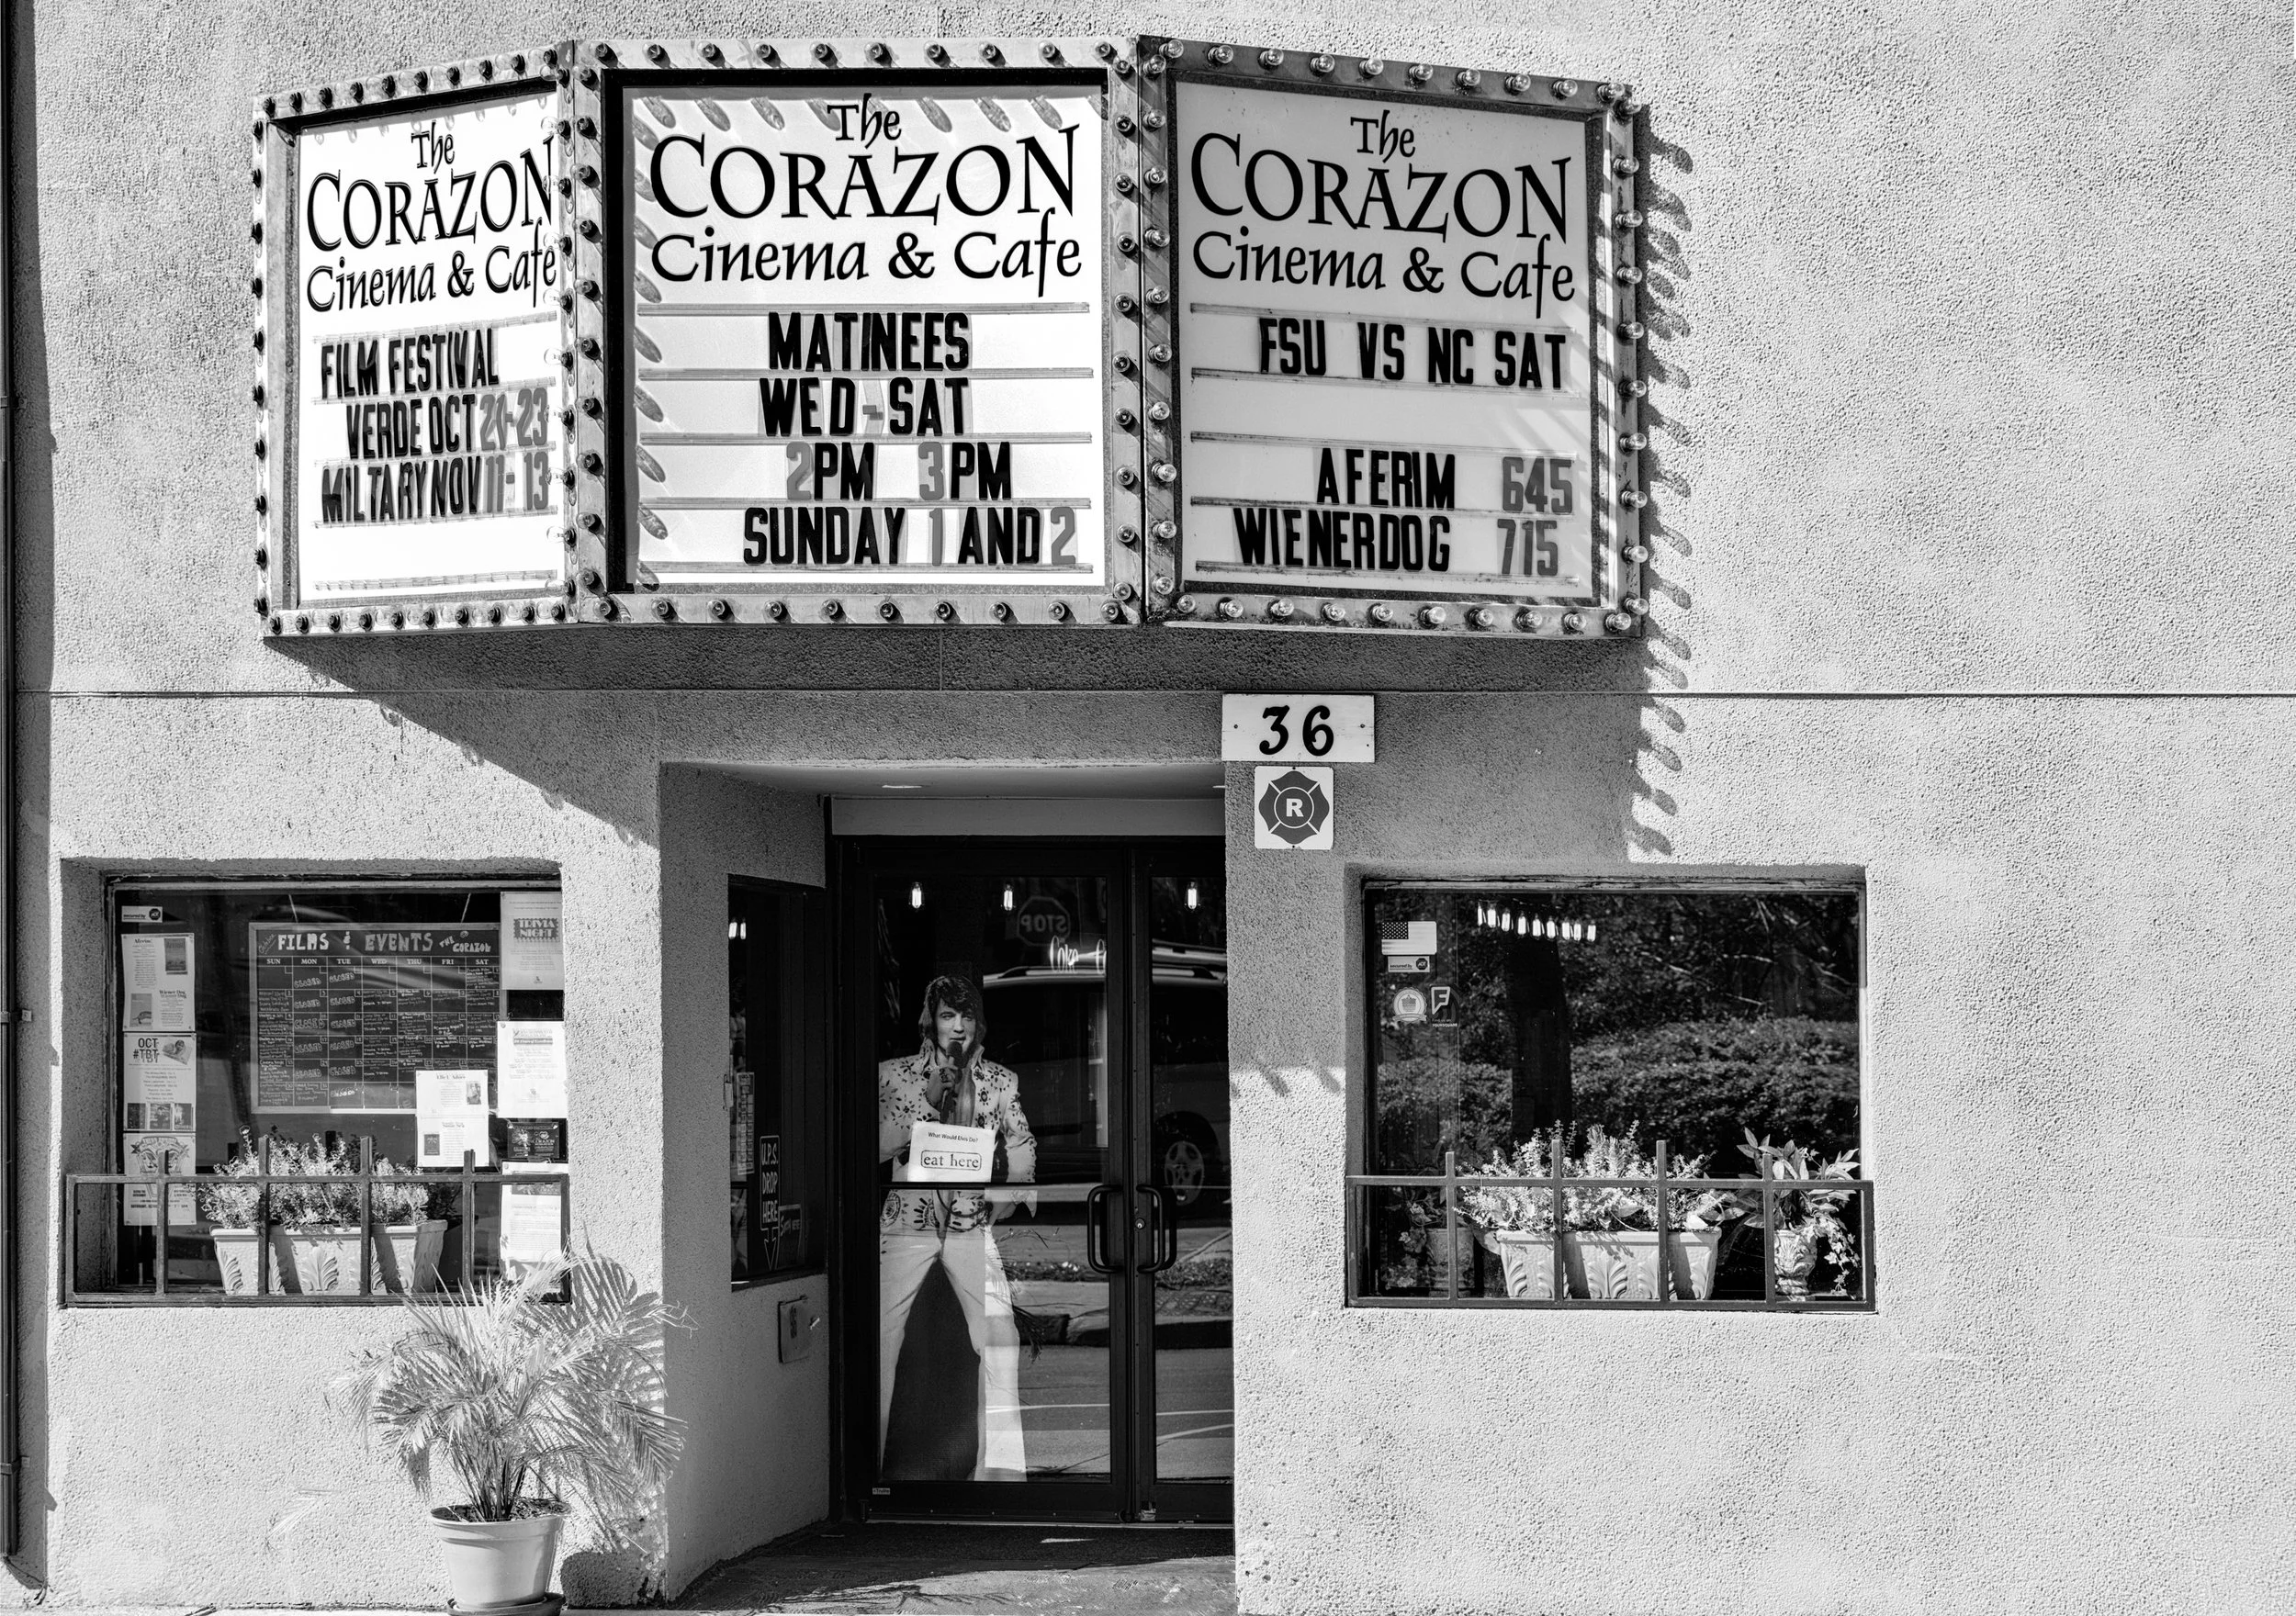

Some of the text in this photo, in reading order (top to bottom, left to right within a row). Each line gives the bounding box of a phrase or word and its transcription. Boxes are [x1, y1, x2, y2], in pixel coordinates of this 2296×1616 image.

[411, 121, 455, 174] The
[827, 93, 901, 149] The
[1350, 109, 1415, 163] The
[306, 135, 557, 252] CORAZON
[650, 124, 1080, 225] CORAZON
[1191, 132, 1571, 244] CORAZON
[307, 219, 557, 312] Cinema & Cafe
[652, 207, 1082, 297] Cinema & Cafe
[1193, 225, 1575, 320] Cinema & Cafe
[321, 328, 500, 400] FILM FESTIVAL
[768, 312, 970, 371] MATINEES
[1259, 318, 1567, 389] FSU VS NC SAT
[346, 401, 422, 459] VERDE
[428, 394, 475, 453] OCT
[432, 456, 481, 517] NOV
[786, 442, 1011, 500] 2PM 3PM
[1316, 447, 1573, 515] AFERIM 645
[743, 506, 1076, 566] SUNDAY 1 AND 2
[1233, 507, 1559, 577] WIENERDOG 715
[1258, 703, 1335, 757] 36
[1285, 798, 1304, 817] R
[277, 933, 329, 950] FILMS
[365, 932, 433, 951] EVENTS
[439, 936, 455, 948] THE
[452, 942, 491, 952] CORAZON
[518, 919, 556, 928] TRIVIA
[520, 928, 553, 937] NIGHT
[138, 1038, 158, 1048] OCT
[761, 1171, 778, 1195] DROP
[923, 1153, 979, 1168] eat here
[762, 1200, 778, 1224] HERE
